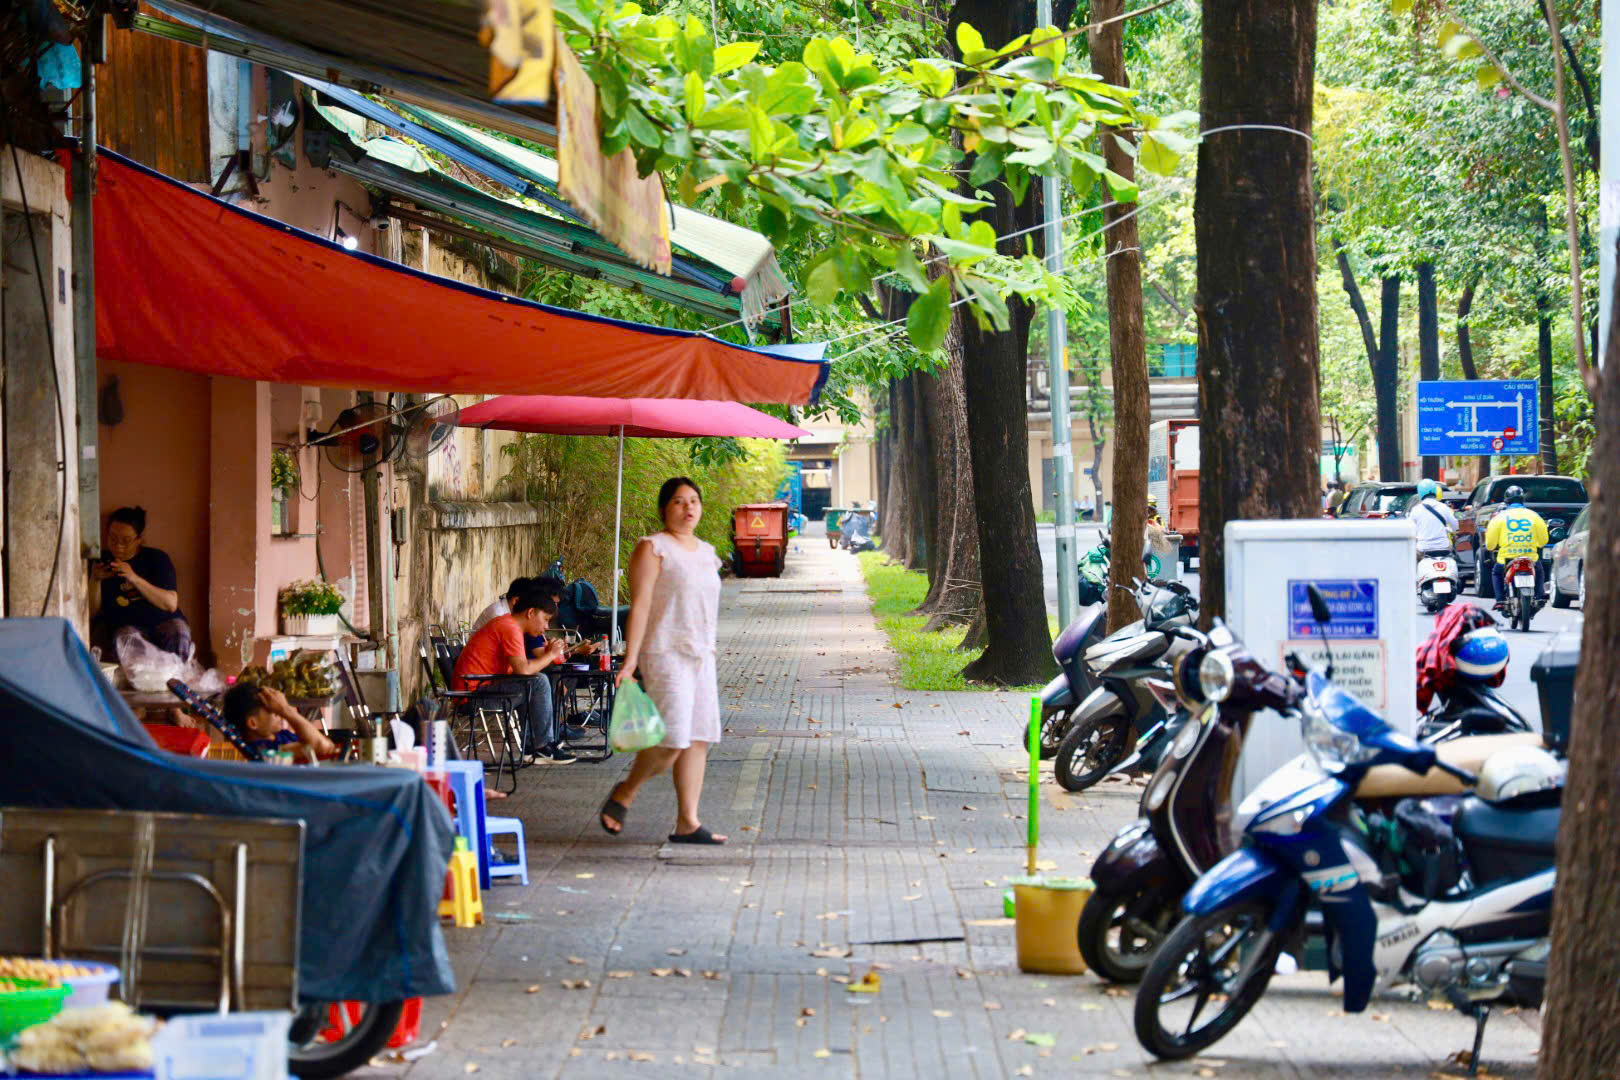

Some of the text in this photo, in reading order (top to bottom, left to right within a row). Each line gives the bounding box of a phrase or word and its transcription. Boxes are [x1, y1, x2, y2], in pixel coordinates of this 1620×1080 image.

[1506, 515, 1532, 532] be
[1507, 532, 1532, 543] Food
[1381, 926, 1421, 948] YAMAHA
